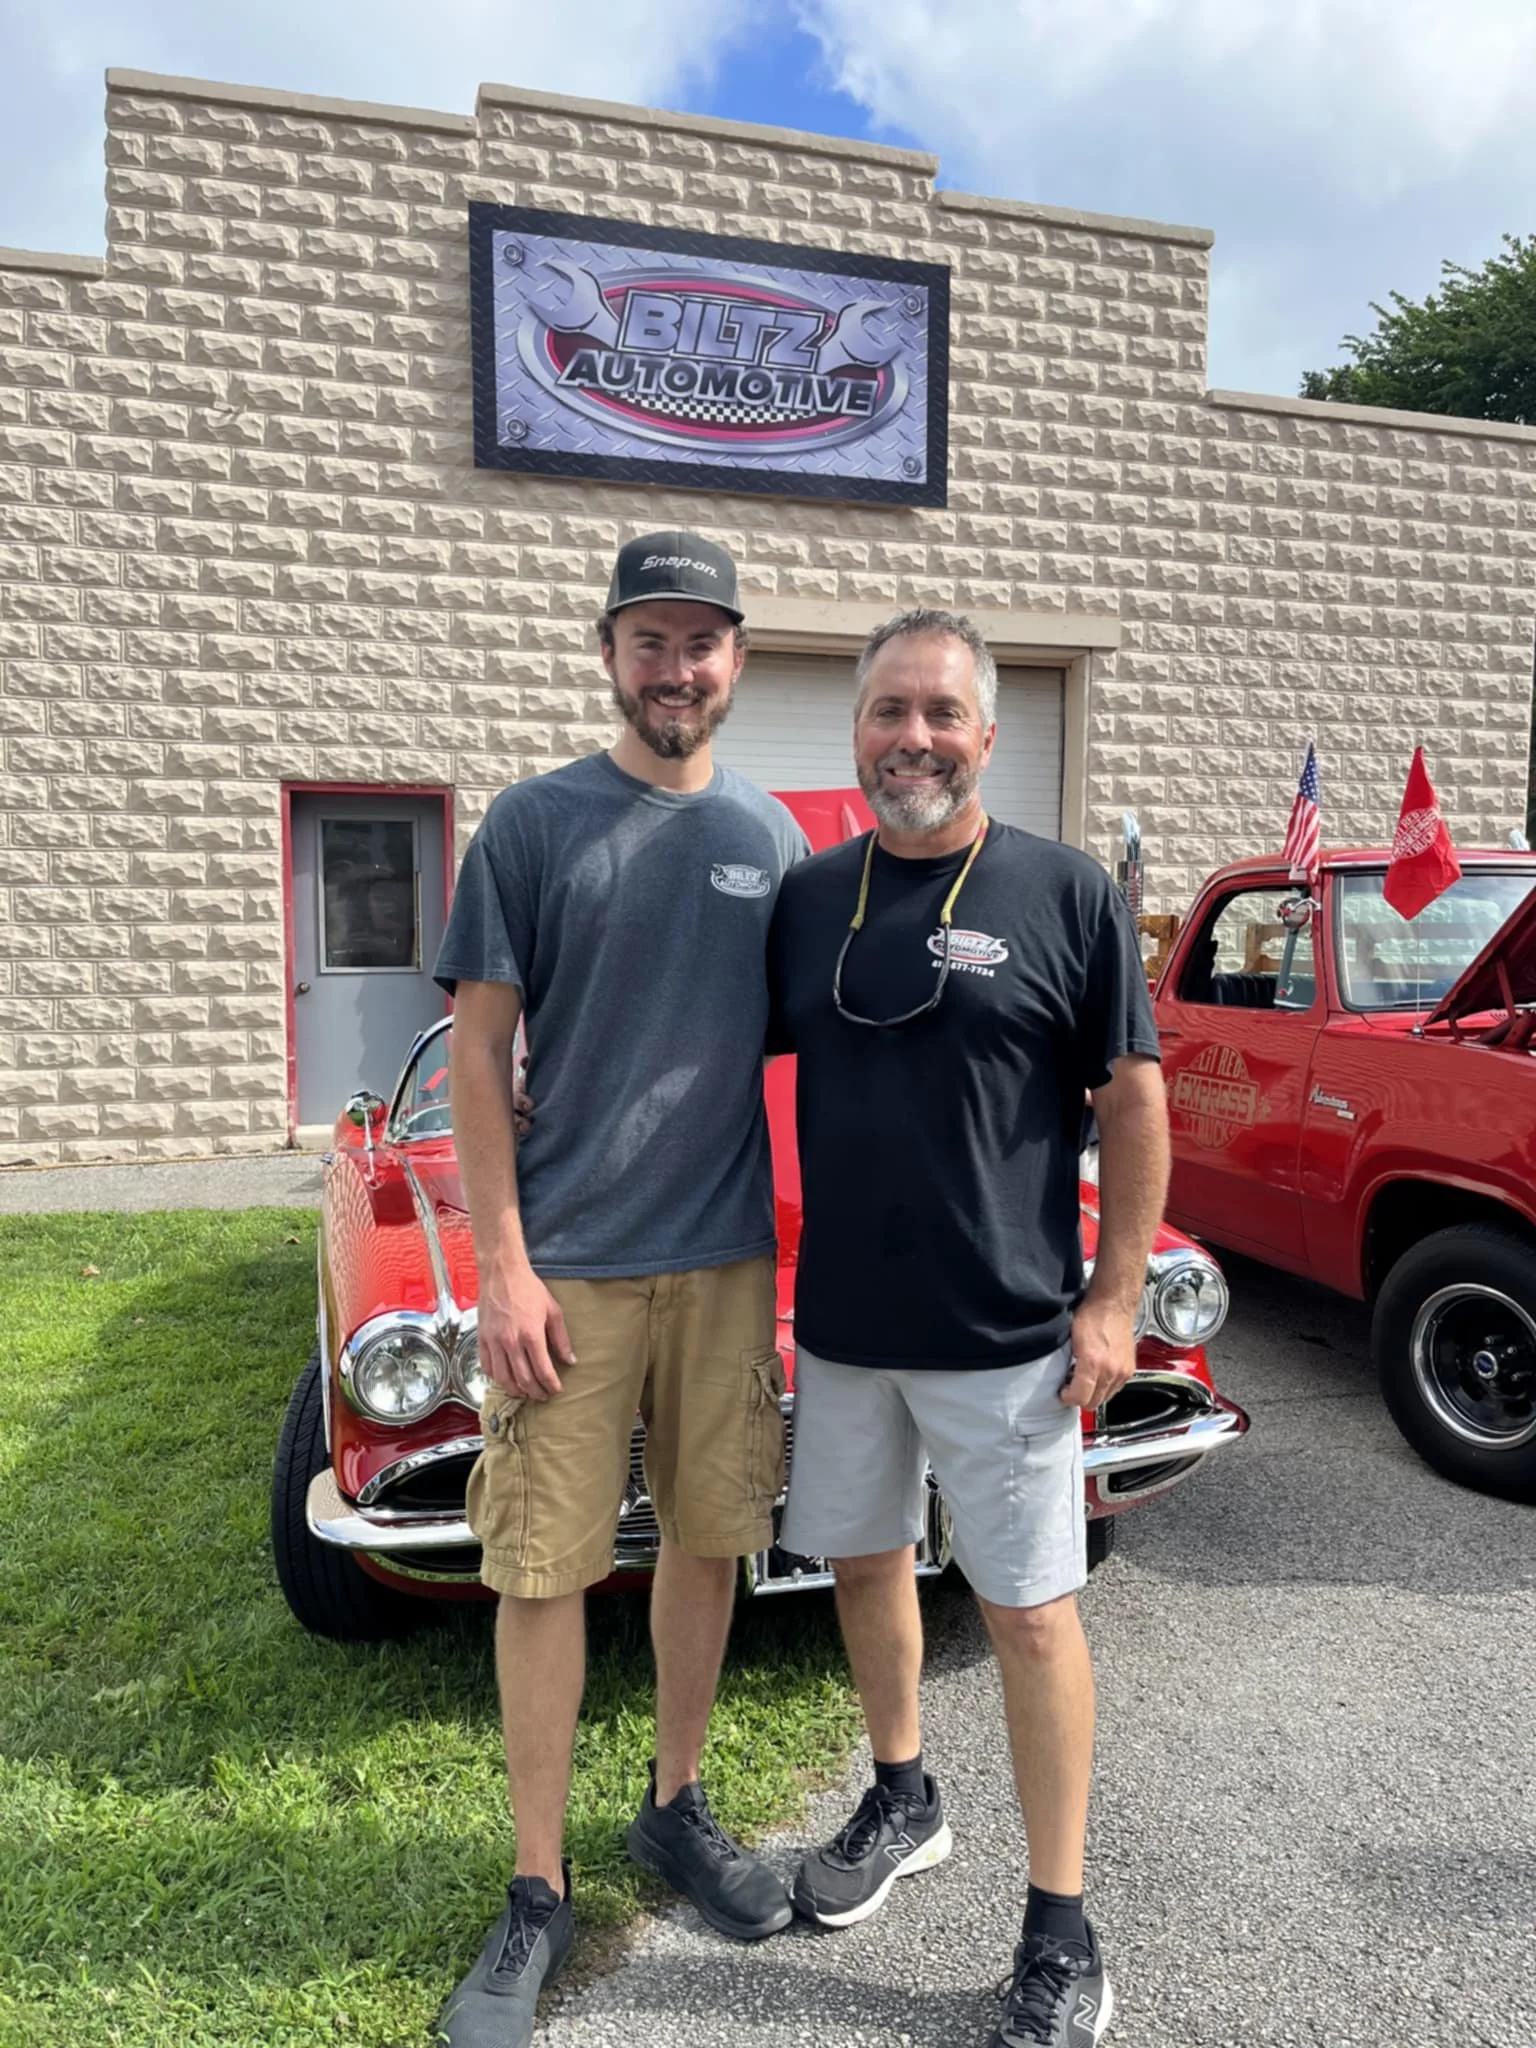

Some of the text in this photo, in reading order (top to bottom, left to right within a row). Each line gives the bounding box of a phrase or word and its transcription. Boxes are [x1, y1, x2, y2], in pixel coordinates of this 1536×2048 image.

[619, 289, 827, 373] BILTZ
[556, 349, 879, 418] AUTOMOTIVE
[934, 941, 1000, 959] ATOMOTIVE
[1217, 1047, 1241, 1080] RED
[1177, 1075, 1252, 1122] EXPRESS
